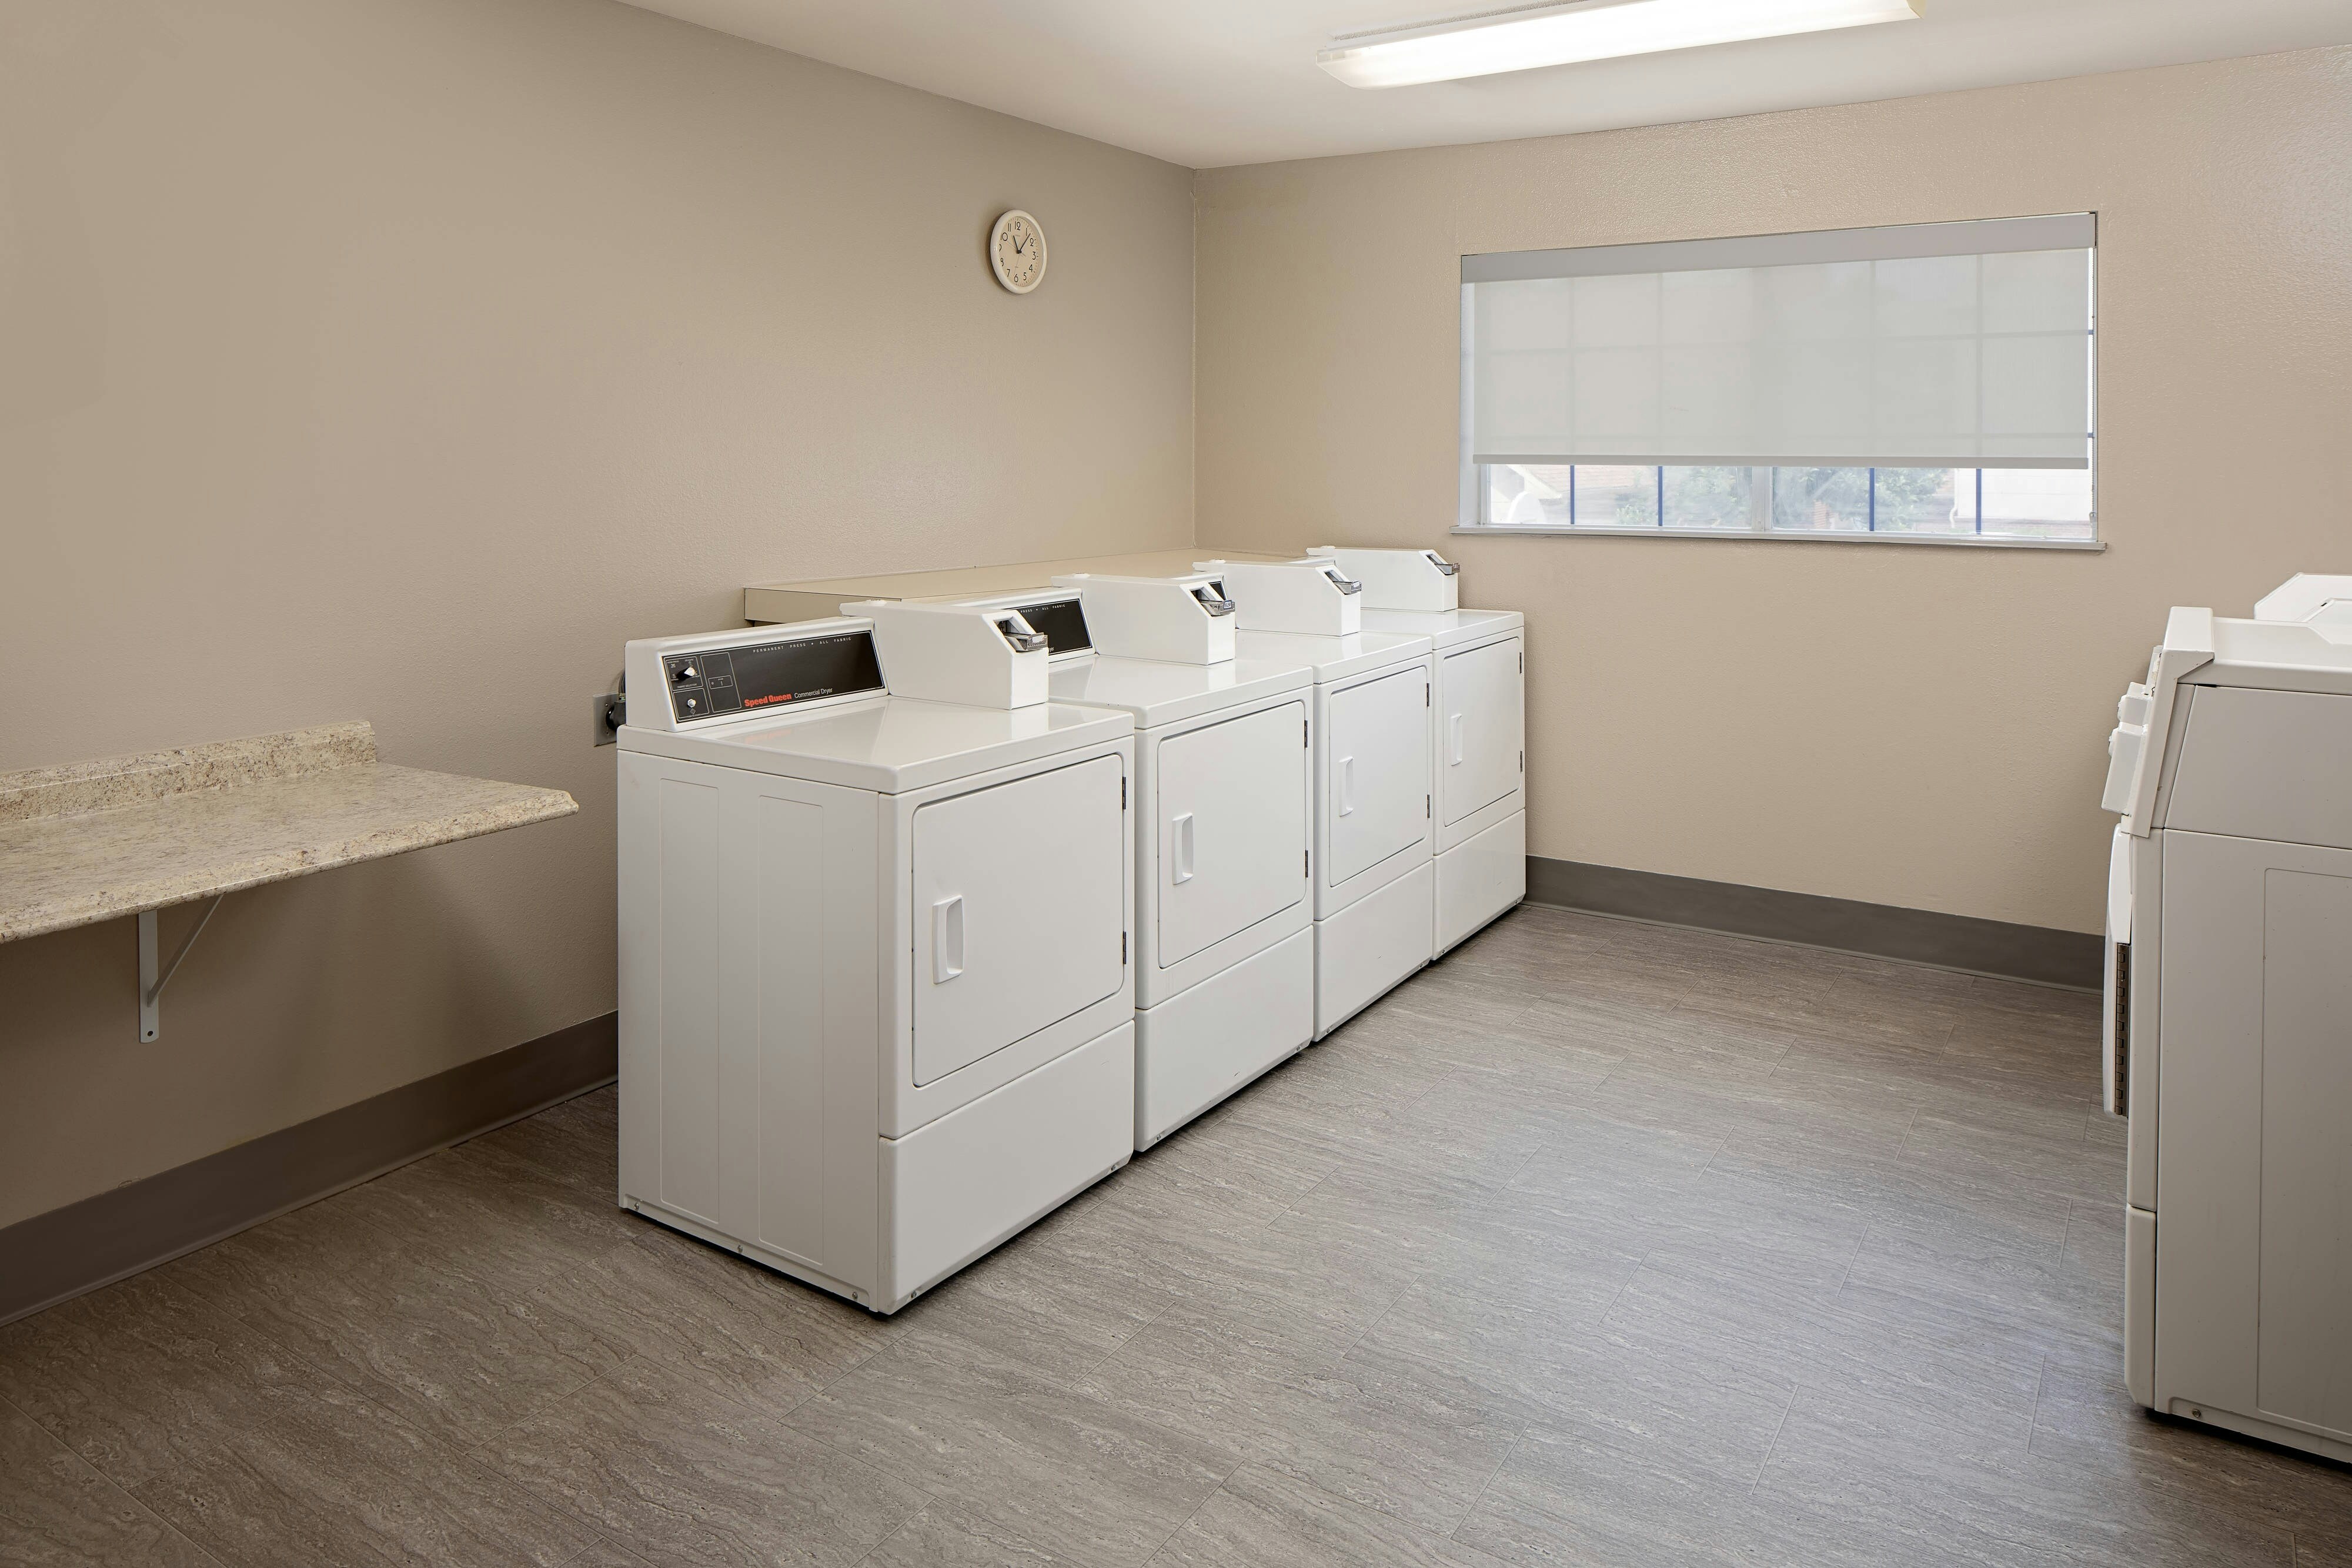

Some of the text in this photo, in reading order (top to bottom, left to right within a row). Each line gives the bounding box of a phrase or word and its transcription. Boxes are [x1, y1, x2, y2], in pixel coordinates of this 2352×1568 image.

[1008, 223, 1011, 232] 11
[1015, 221, 1020, 230] 12
[1000, 232, 1008, 242] 10
[1030, 238, 1034, 247] 2
[1032, 251, 1036, 260] 3
[1000, 258, 1004, 266] 8
[1028, 263, 1033, 272] 4
[1007, 269, 1010, 278] 7
[1014, 273, 1019, 283] 6
[1023, 272, 1027, 281] 5
[753, 645, 784, 653] PERMANENT
[744, 696, 768, 707] Speed
[768, 693, 792, 703] Queen
[794, 689, 820, 698] Commercial
